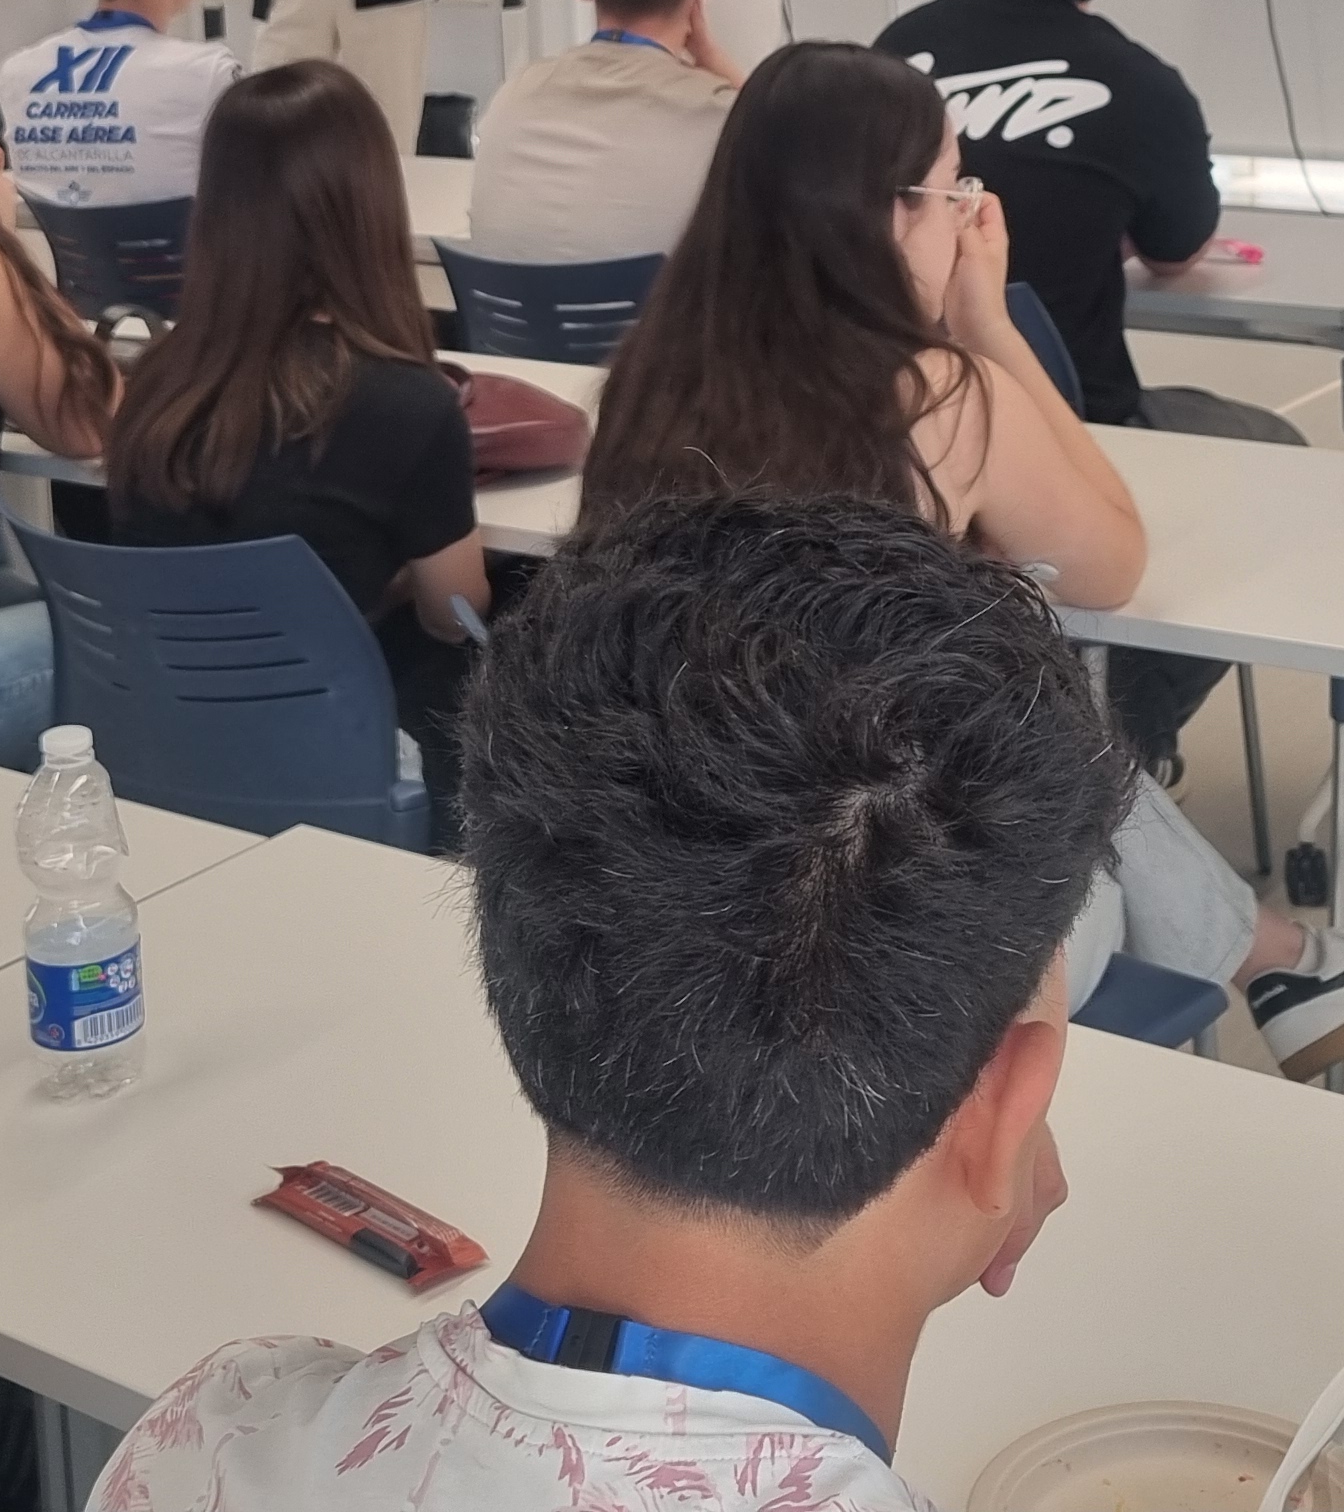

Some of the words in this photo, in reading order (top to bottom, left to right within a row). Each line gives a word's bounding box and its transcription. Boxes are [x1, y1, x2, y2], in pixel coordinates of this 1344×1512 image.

[29, 44, 138, 94] XII
[26, 100, 120, 120] CARRERA
[14, 125, 63, 144] BASE
[66, 121, 137, 144] AÉREA
[34, 148, 134, 161] ALCANTARILLA
